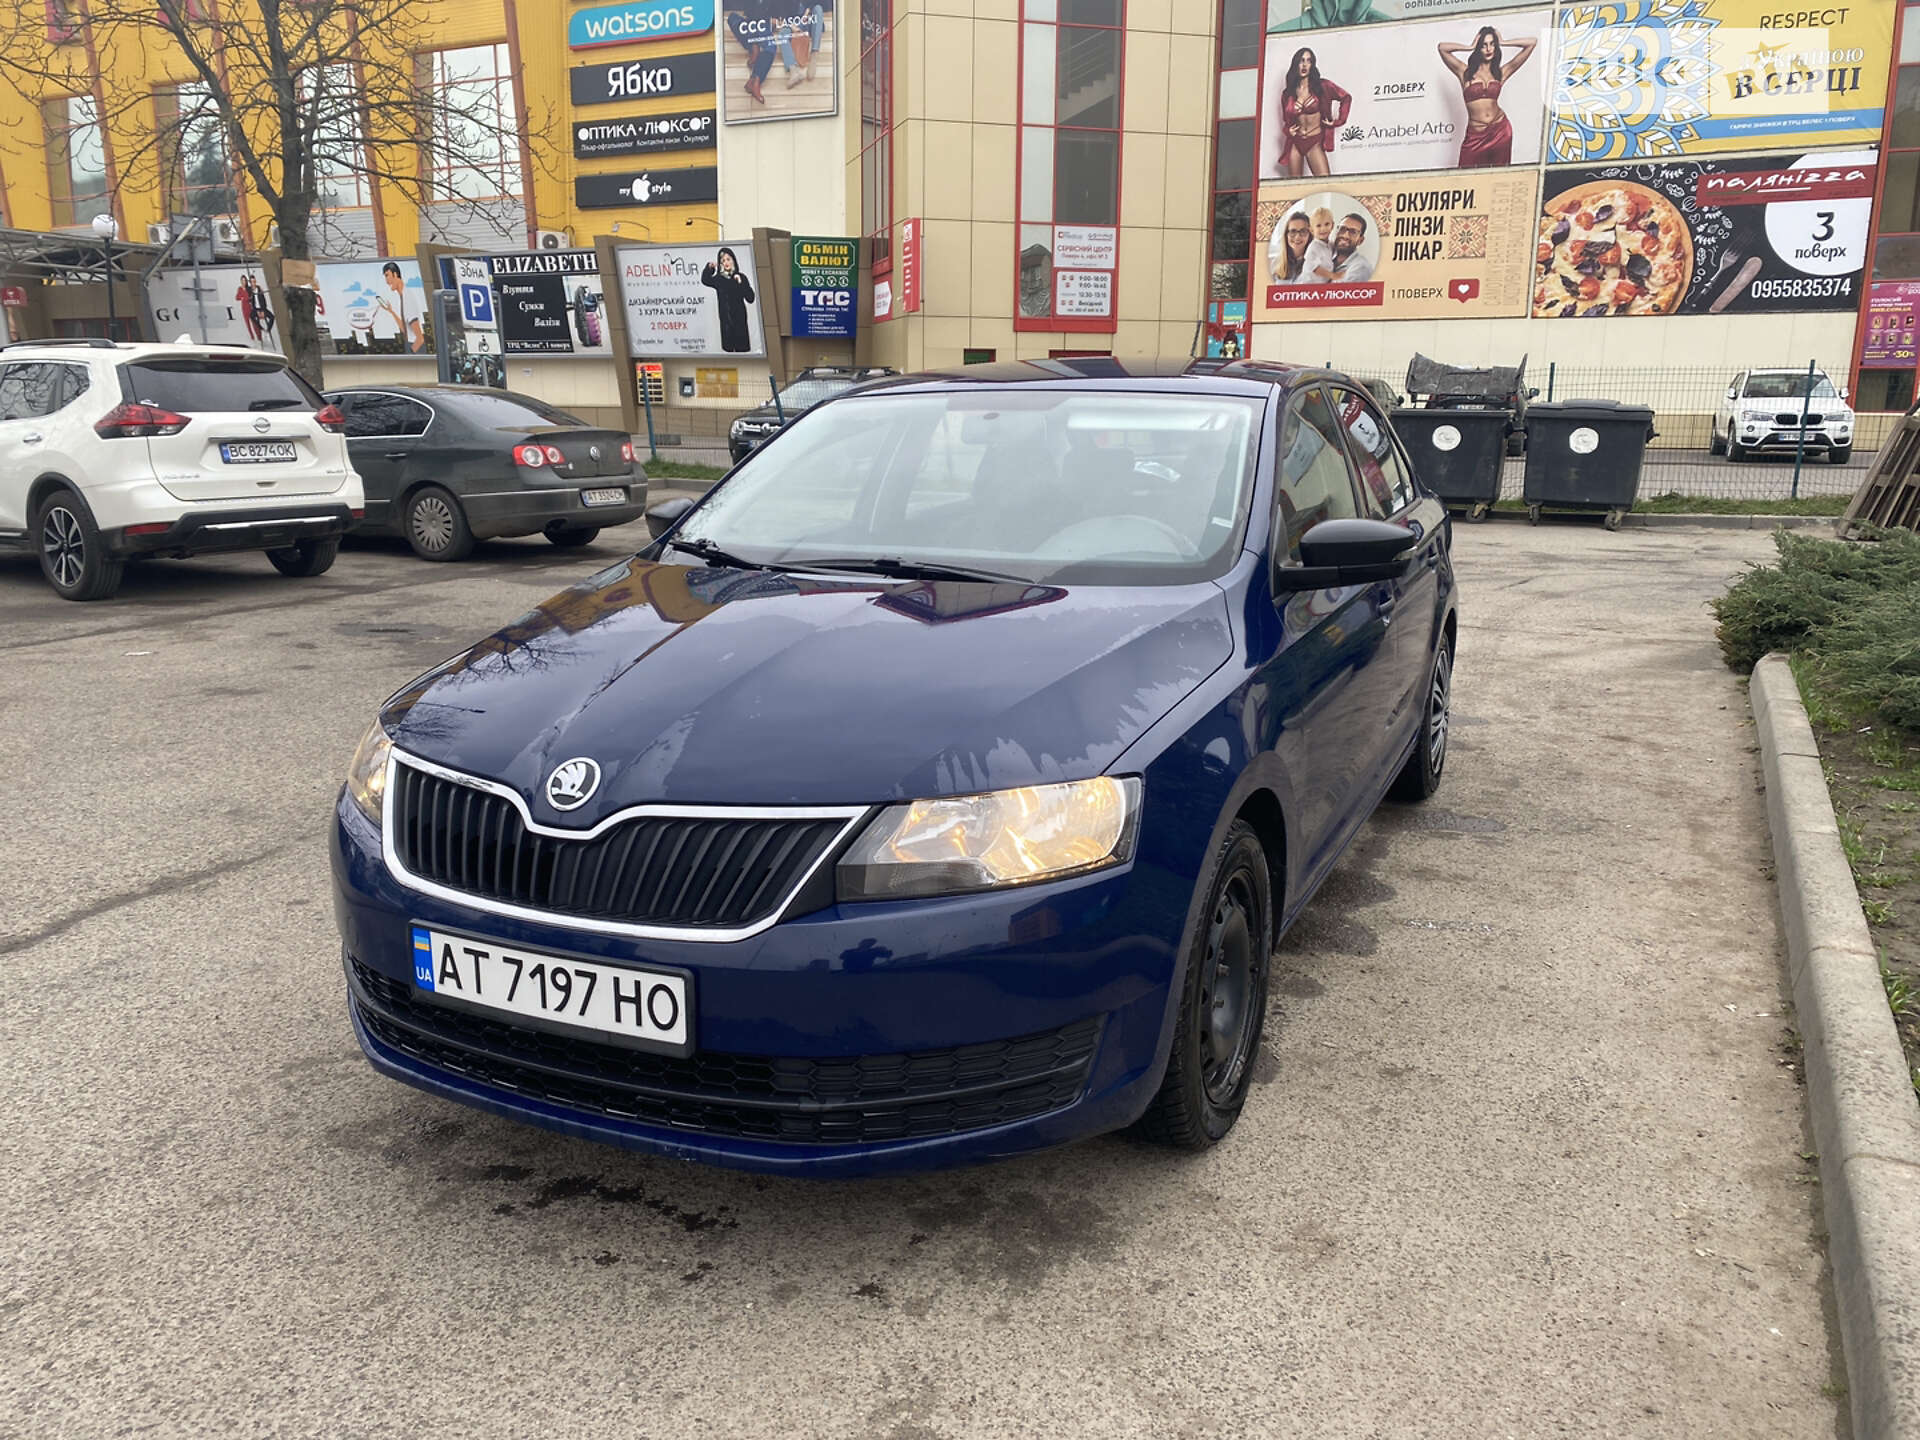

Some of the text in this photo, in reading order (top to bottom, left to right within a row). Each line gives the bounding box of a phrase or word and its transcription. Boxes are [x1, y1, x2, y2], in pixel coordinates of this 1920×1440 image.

[585, 5, 694, 39] watsons
[739, 14, 819, 35] CCC LASOCKI
[1759, 8, 1850, 30] RESPECT
[607, 61, 672, 97] Ябко
[1373, 82, 1426, 96] 2 ПОВЕРХ
[1367, 122, 1455, 139] Anabel Arto
[619, 182, 672, 197] my style
[1395, 189, 1477, 213] ОКУЛЯРИ.
[1393, 216, 1447, 238] ЛІНЗИ.
[1811, 211, 1836, 242] 3
[802, 243, 849, 255] ОБМІН
[1392, 240, 1446, 262] ЛІКАР.
[1794, 243, 1847, 262] поверх
[492, 252, 598, 275] ELIZABETH
[626, 262, 700, 278] ADELIN FUR
[800, 255, 850, 266] ВАЛЮТ
[460, 266, 485, 279] ЗОНА
[1397, 288, 1444, 299] ПОВЕРХ
[1750, 279, 1851, 299] 0955835374
[650, 321, 688, 330] 2 ПОВЕРХ
[229, 443, 294, 458] BC 8274 OK
[416, 966, 433, 983] UA
[438, 943, 680, 1032] AT 7197 HO
